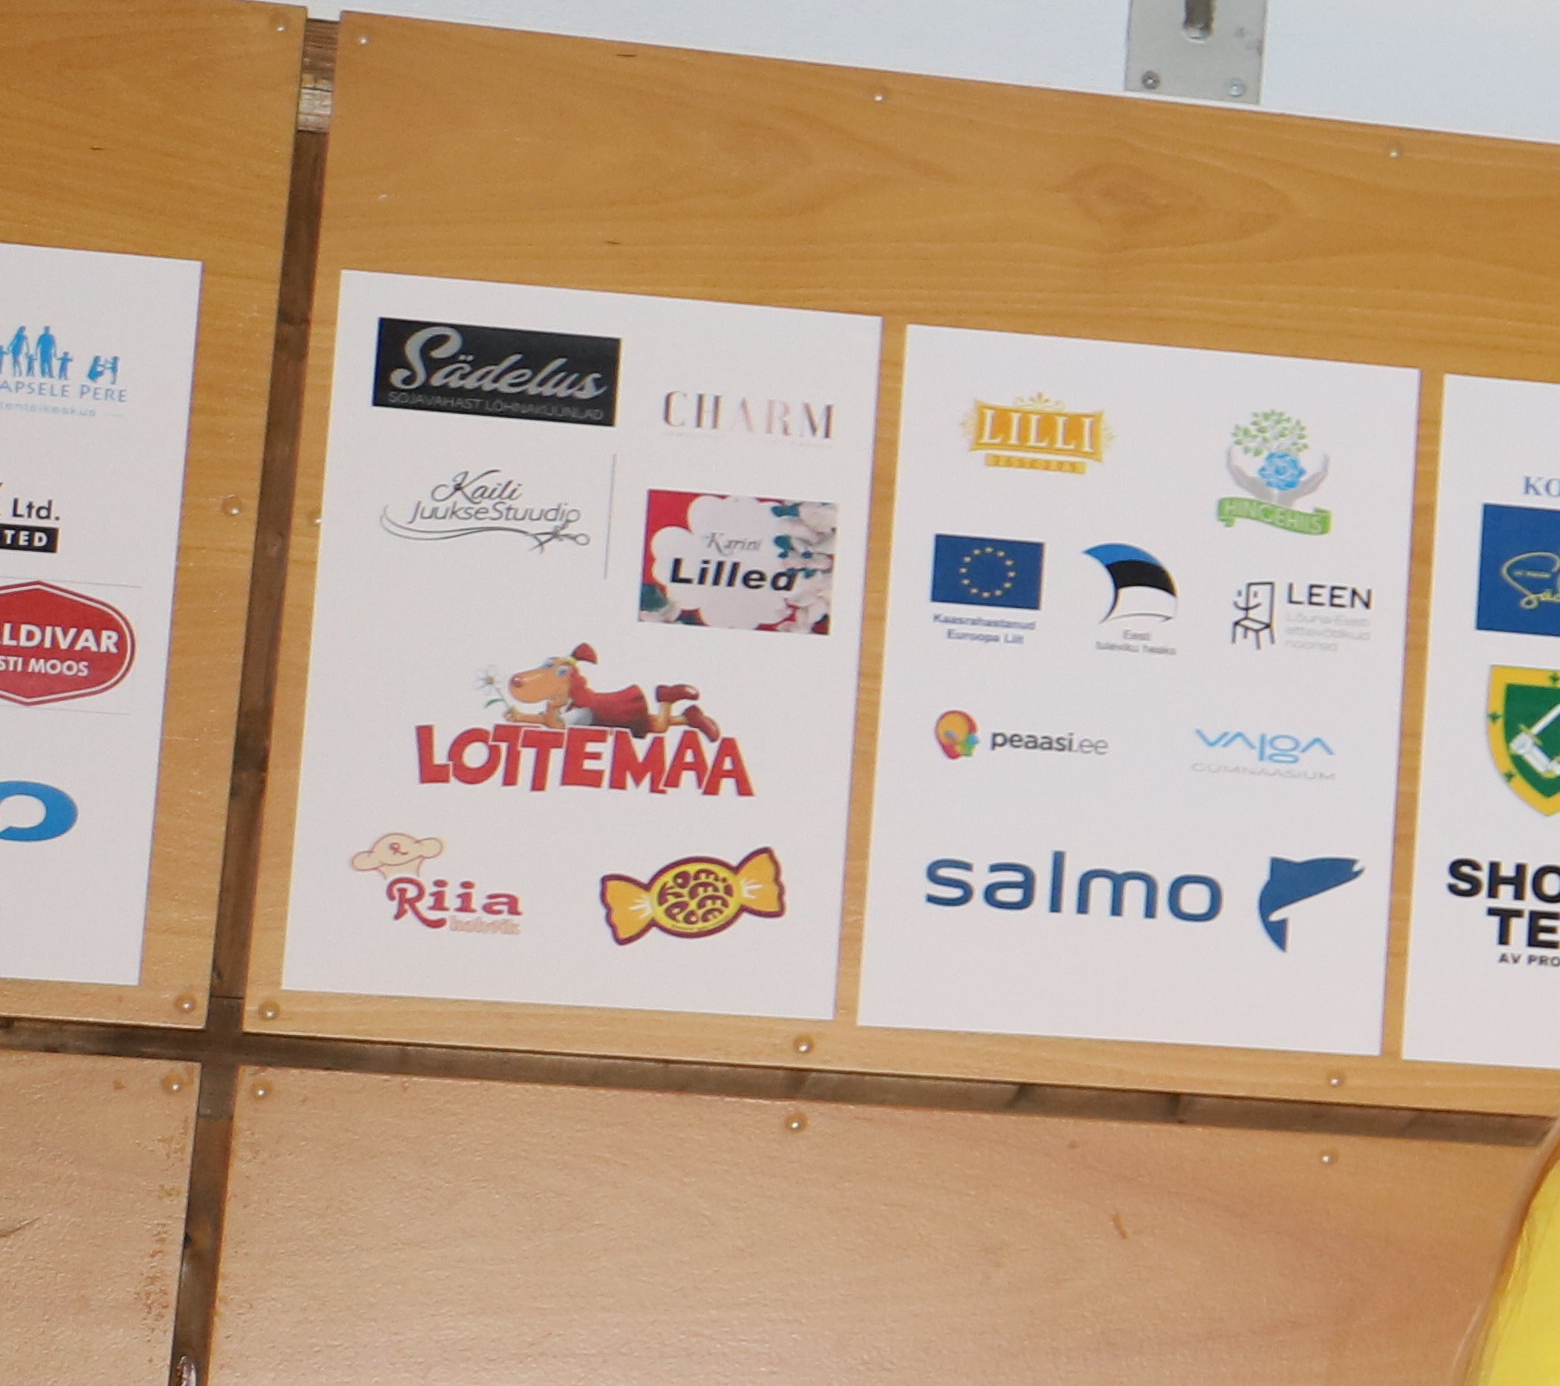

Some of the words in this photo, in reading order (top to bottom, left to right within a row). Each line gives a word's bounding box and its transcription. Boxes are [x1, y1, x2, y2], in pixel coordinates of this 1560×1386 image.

[389, 326, 609, 400] Sädelus
[79, 384, 127, 403] PERE
[663, 390, 835, 439] CHARM
[979, 409, 1095, 453] LILLI
[431, 469, 523, 504] Kaili
[12, 498, 60, 521] Ltd.
[1287, 581, 1373, 610] LEEN
[0, 622, 120, 654] LDIVAR
[28, 658, 90, 677] MOOS
[990, 731, 1109, 755] peaasi.ee
[415, 723, 756, 797] LOTTEMAA
[386, 876, 523, 929] Riia
[925, 849, 1223, 923] salmo
[1498, 952, 1522, 964] AV
